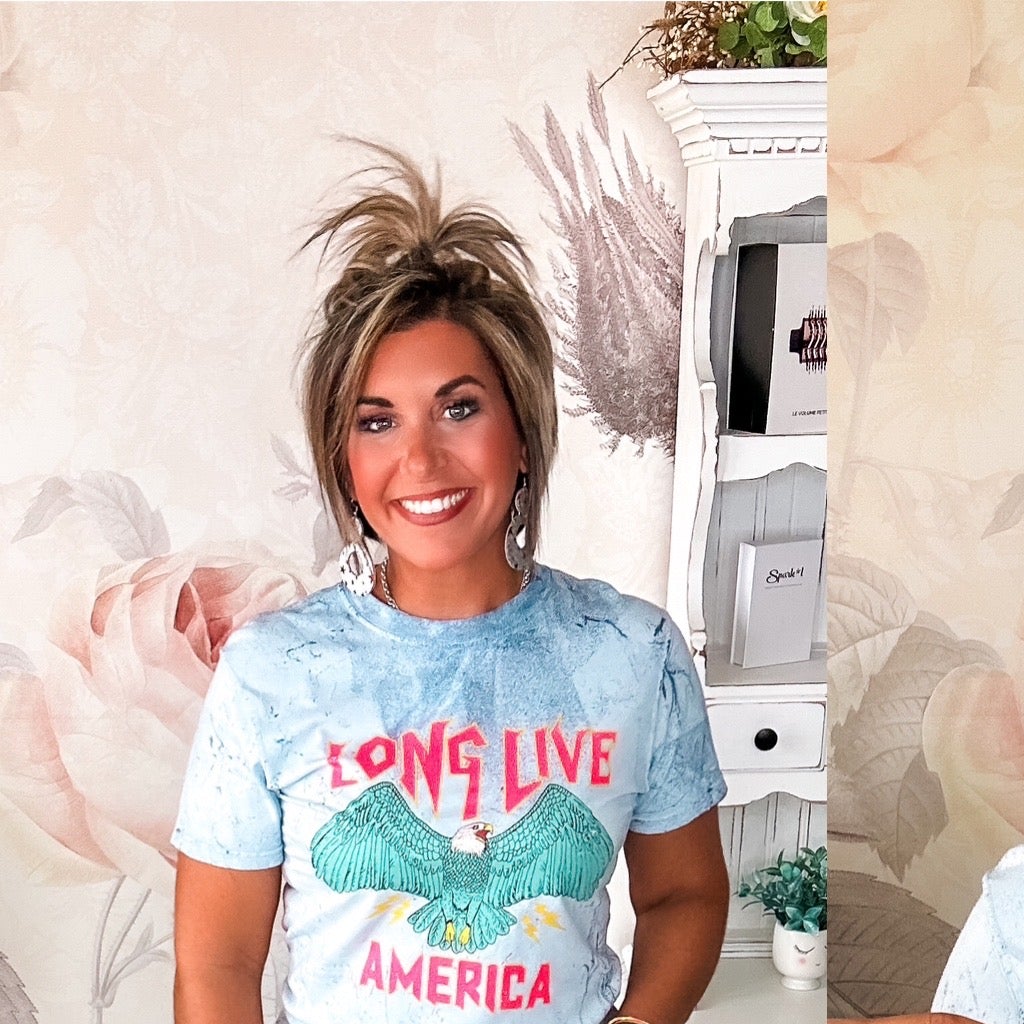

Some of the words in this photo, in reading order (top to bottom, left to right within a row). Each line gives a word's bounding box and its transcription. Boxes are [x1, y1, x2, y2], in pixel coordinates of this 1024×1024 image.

[766, 567, 796, 584] Spark
[326, 718, 488, 820] LONG
[503, 714, 619, 815] LIVE
[358, 939, 553, 1014] AMERICA
